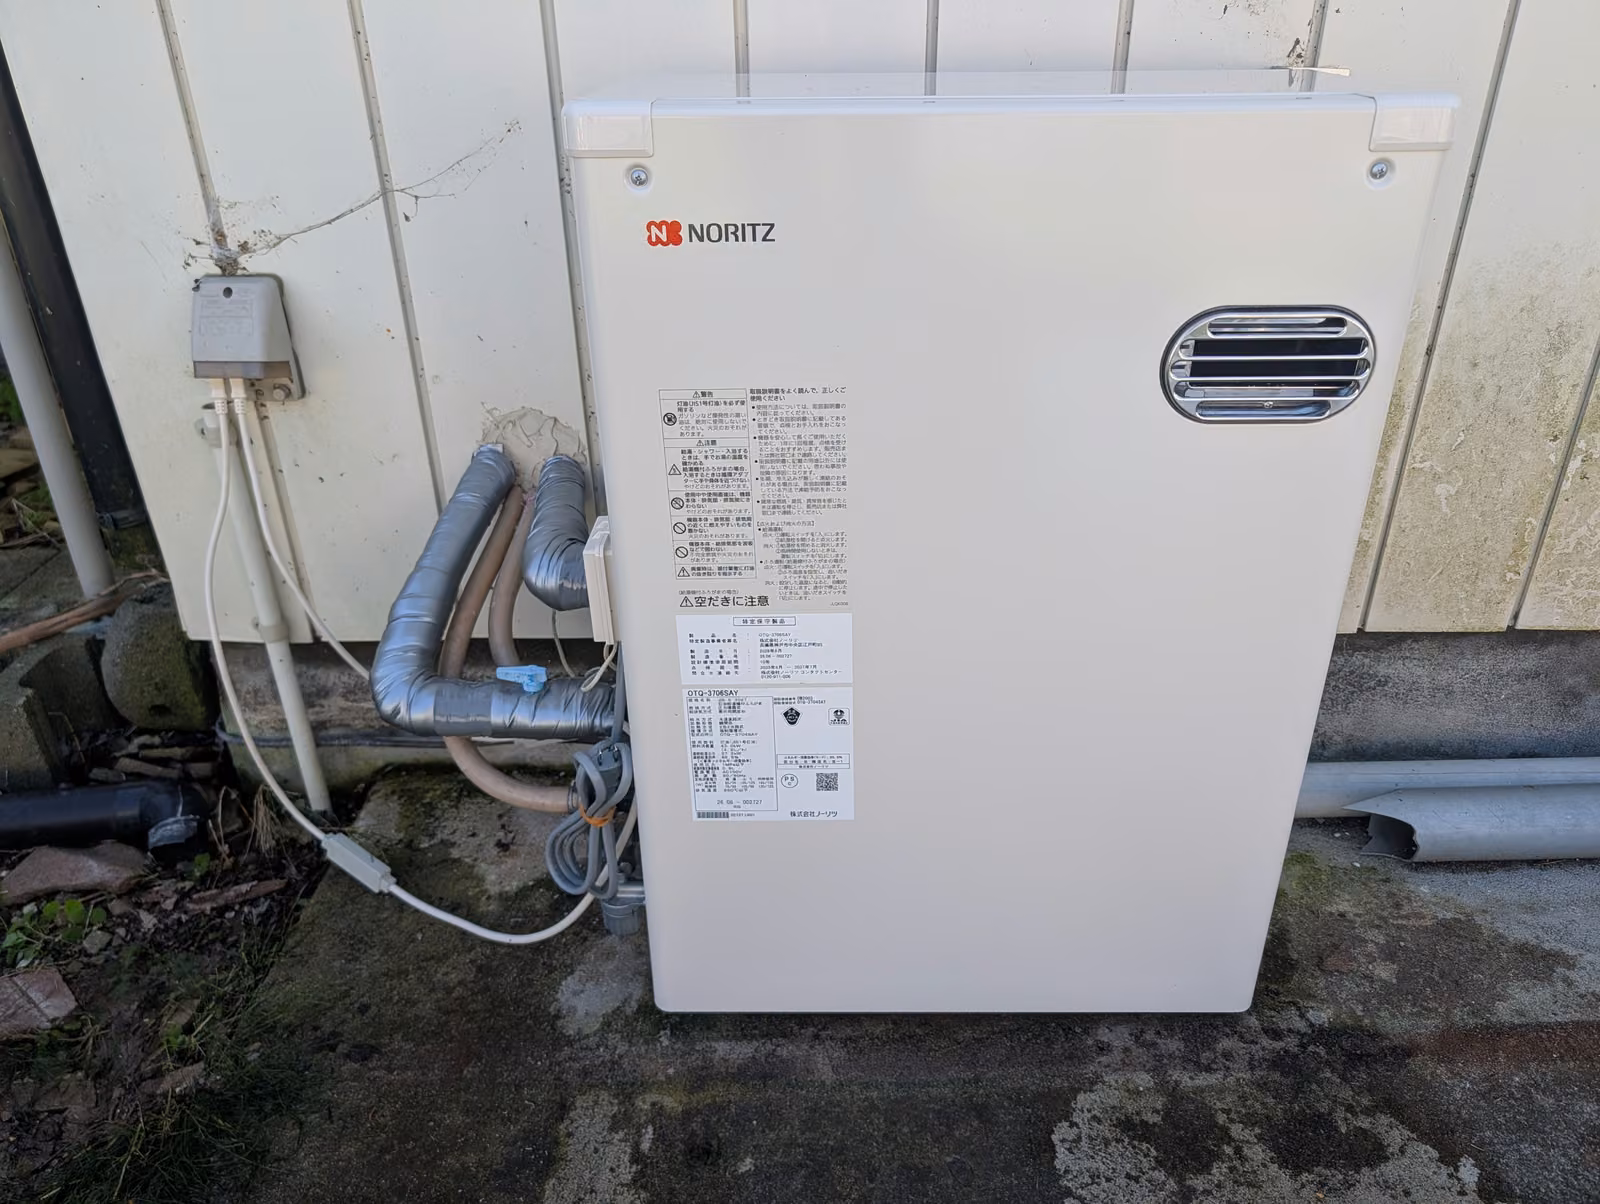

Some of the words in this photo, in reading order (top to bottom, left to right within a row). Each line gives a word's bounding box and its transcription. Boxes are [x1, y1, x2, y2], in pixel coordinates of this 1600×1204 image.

[688, 223, 776, 242] NORITZ
[694, 596, 770, 607] 空だきに注意
